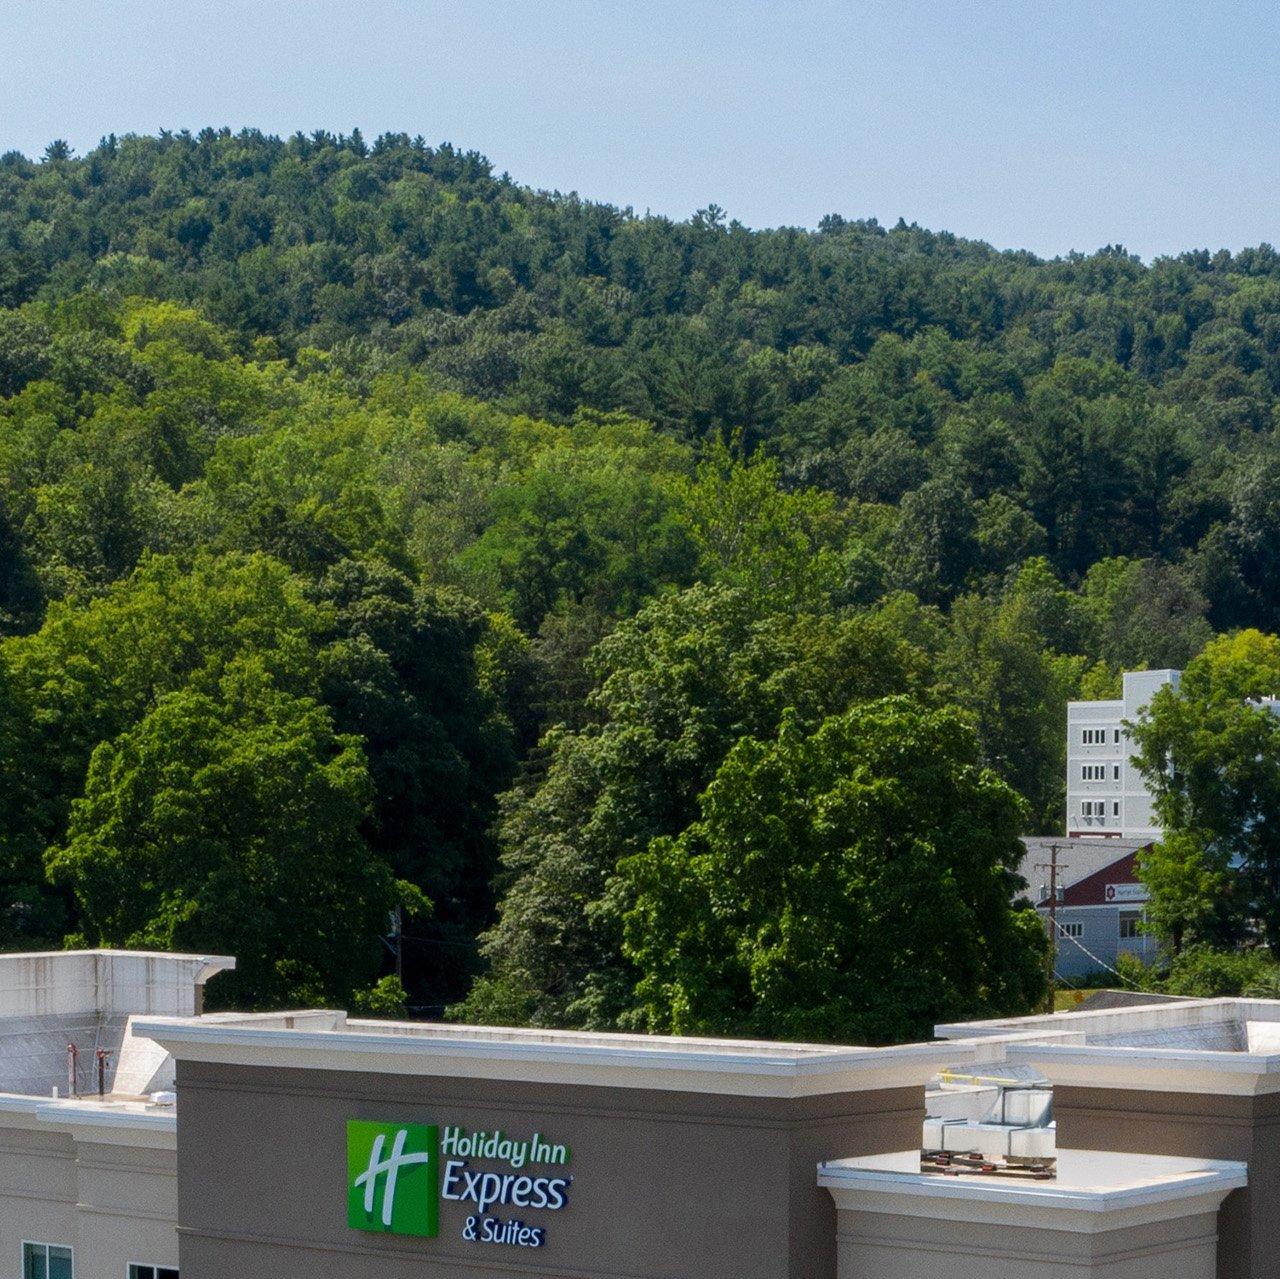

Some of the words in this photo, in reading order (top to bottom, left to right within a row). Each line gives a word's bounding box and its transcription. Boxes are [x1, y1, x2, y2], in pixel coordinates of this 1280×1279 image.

[441, 1126, 526, 1167] Holiday
[531, 1133, 566, 1164] Inn
[441, 1160, 567, 1213] Express
[462, 1216, 476, 1242] &
[480, 1218, 541, 1247] Suites
